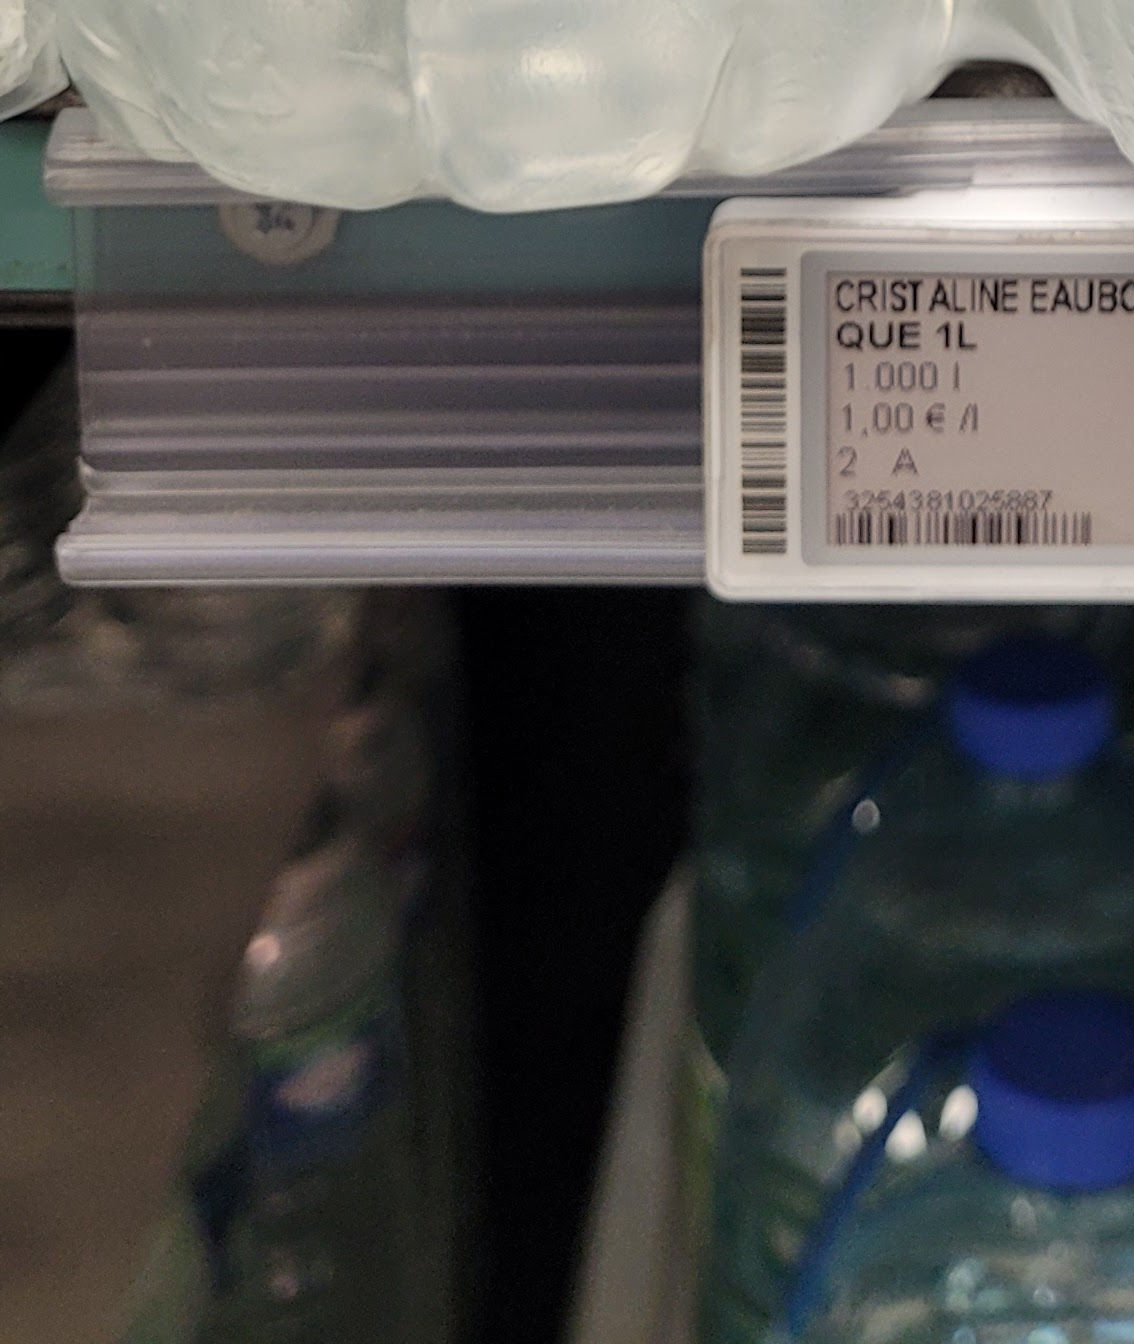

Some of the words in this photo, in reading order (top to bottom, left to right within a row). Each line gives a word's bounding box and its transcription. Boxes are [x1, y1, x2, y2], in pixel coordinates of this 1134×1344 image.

[836, 279, 1019, 313] CRISTALINE
[837, 320, 922, 352] QUE
[936, 320, 978, 351] 1L
[841, 402, 915, 438] 1,00
[925, 402, 947, 433] €
[837, 446, 858, 477] 2
[890, 446, 920, 477] A
